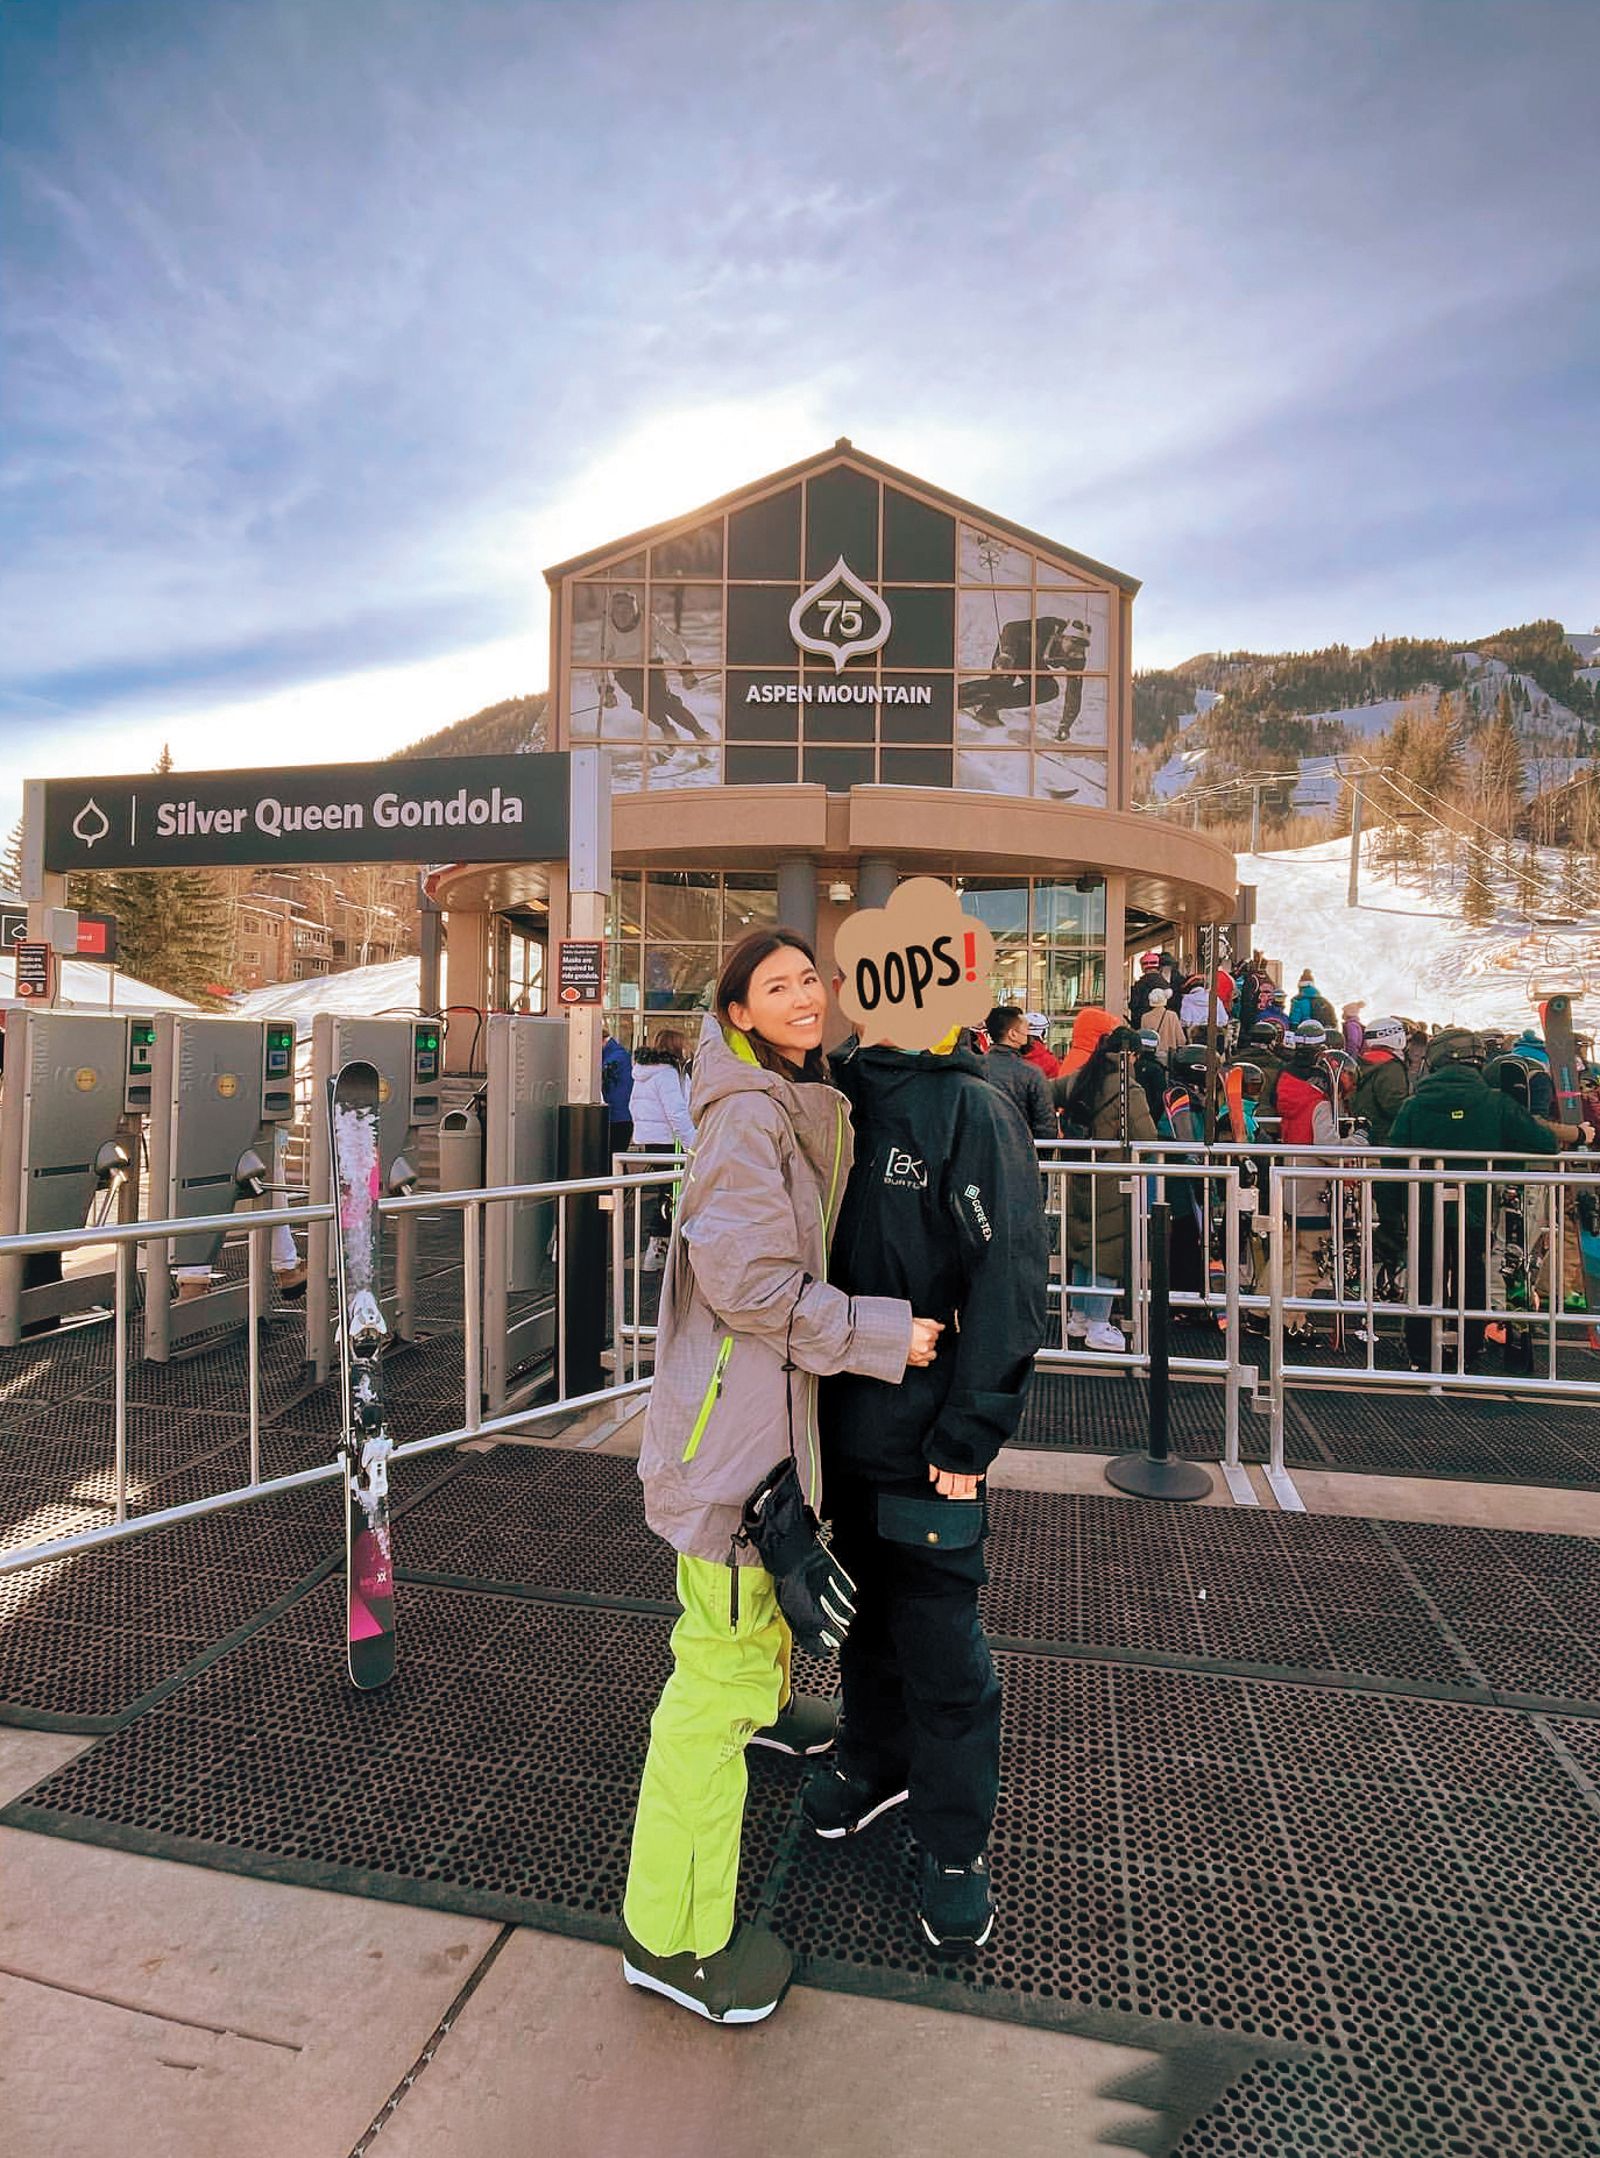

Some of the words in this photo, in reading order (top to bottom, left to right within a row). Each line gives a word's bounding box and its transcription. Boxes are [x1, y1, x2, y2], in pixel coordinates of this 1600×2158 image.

[817, 600, 863, 638] 75
[745, 685, 812, 704] ASPEN
[817, 685, 932, 704] MOUNTAIN
[156, 800, 248, 837] Silver
[254, 798, 364, 838] Queen
[373, 787, 524, 828] Gondola
